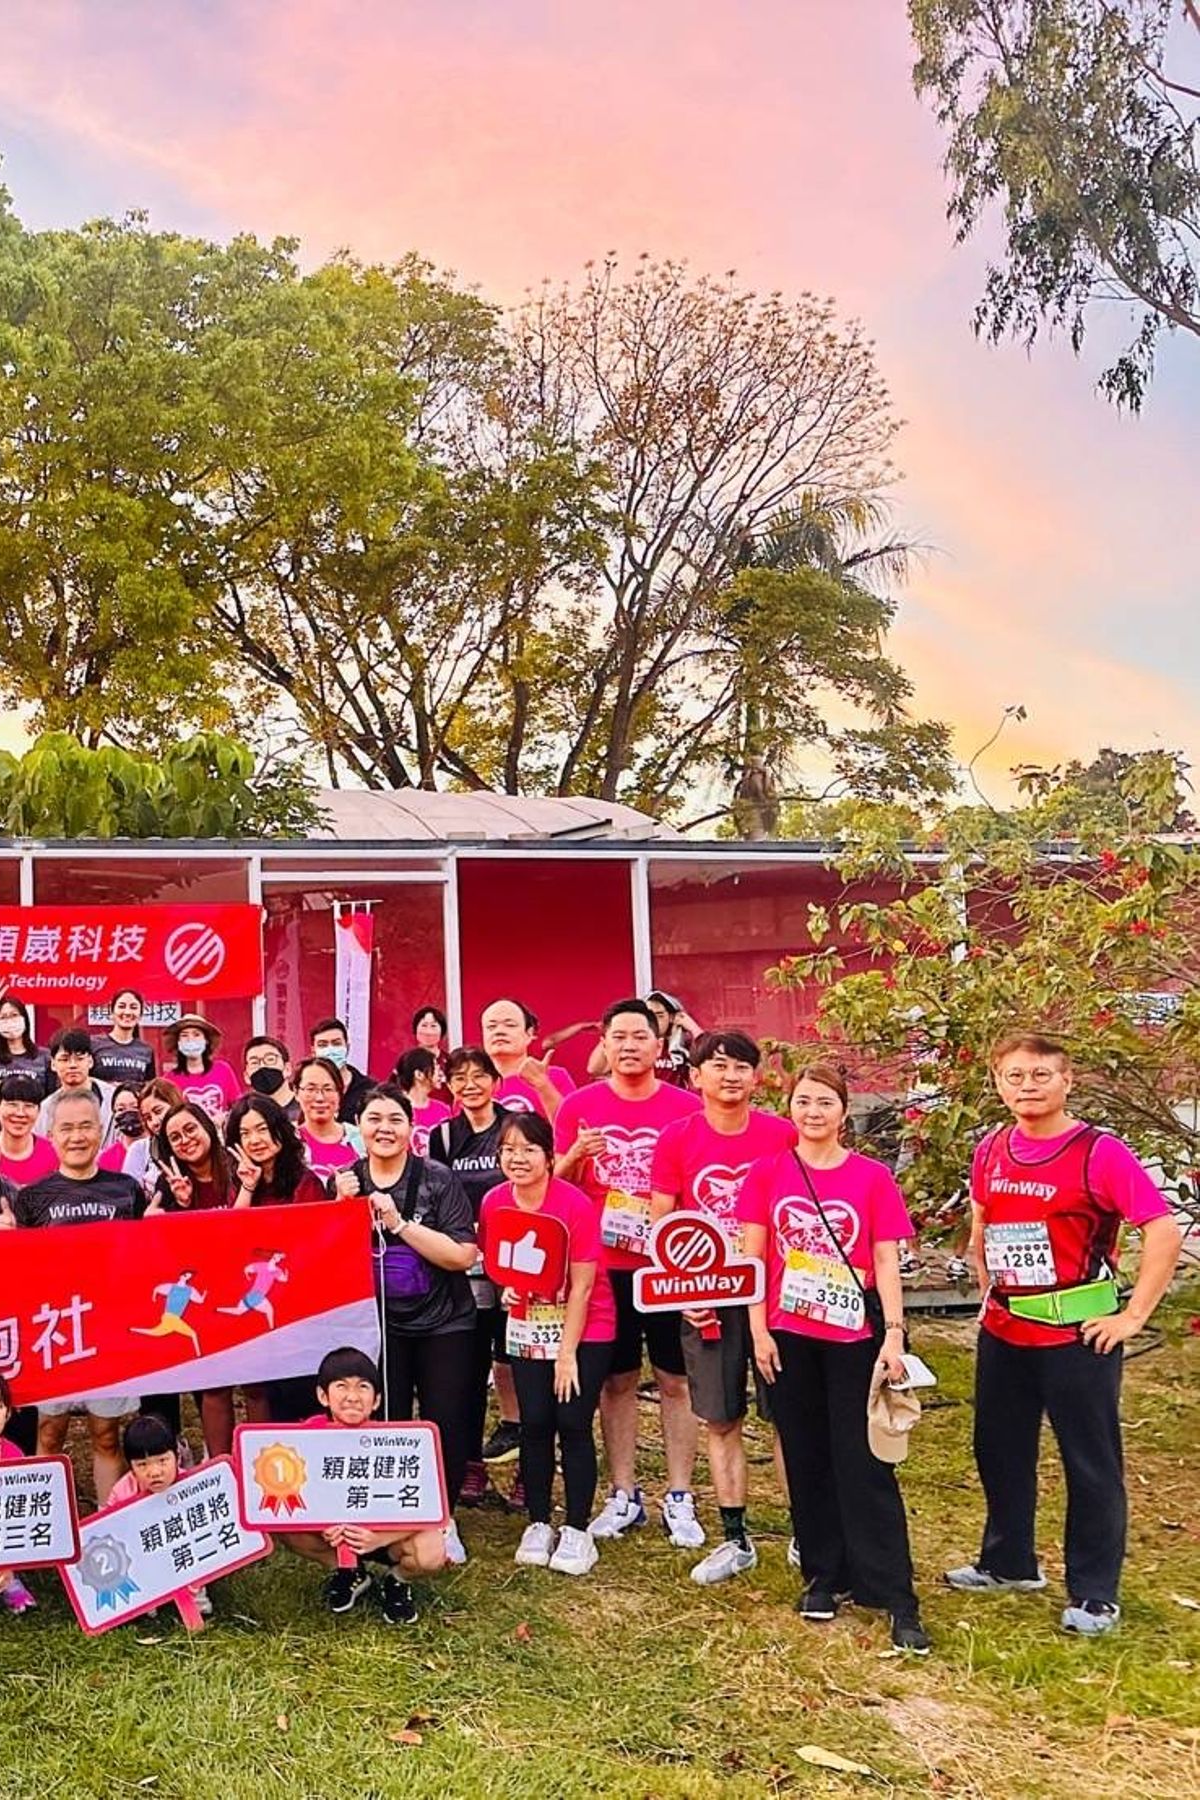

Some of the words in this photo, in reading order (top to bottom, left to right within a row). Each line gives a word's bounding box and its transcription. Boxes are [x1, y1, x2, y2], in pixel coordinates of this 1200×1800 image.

[9, 974, 107, 991] Technology
[101, 1056, 146, 1071] WinWay
[990, 1179, 1058, 1202] WinWay
[49, 1202, 116, 1220] WinWay
[1003, 1252, 1047, 1268] 1284
[651, 1274, 746, 1296] WinWay
[816, 1289, 860, 1312] 3330
[531, 1331, 561, 1344] 332
[373, 1436, 421, 1448] WinWay
[273, 1460, 285, 1483] 1
[322, 1454, 420, 1480] 穎崴健將
[4, 1472, 53, 1486] WinWay
[178, 1474, 222, 1502] WinWay
[346, 1484, 420, 1509] 第一名
[140, 1492, 230, 1553] 穎崴健將
[171, 1522, 241, 1573] 第二名
[96, 1553, 114, 1576] 2
